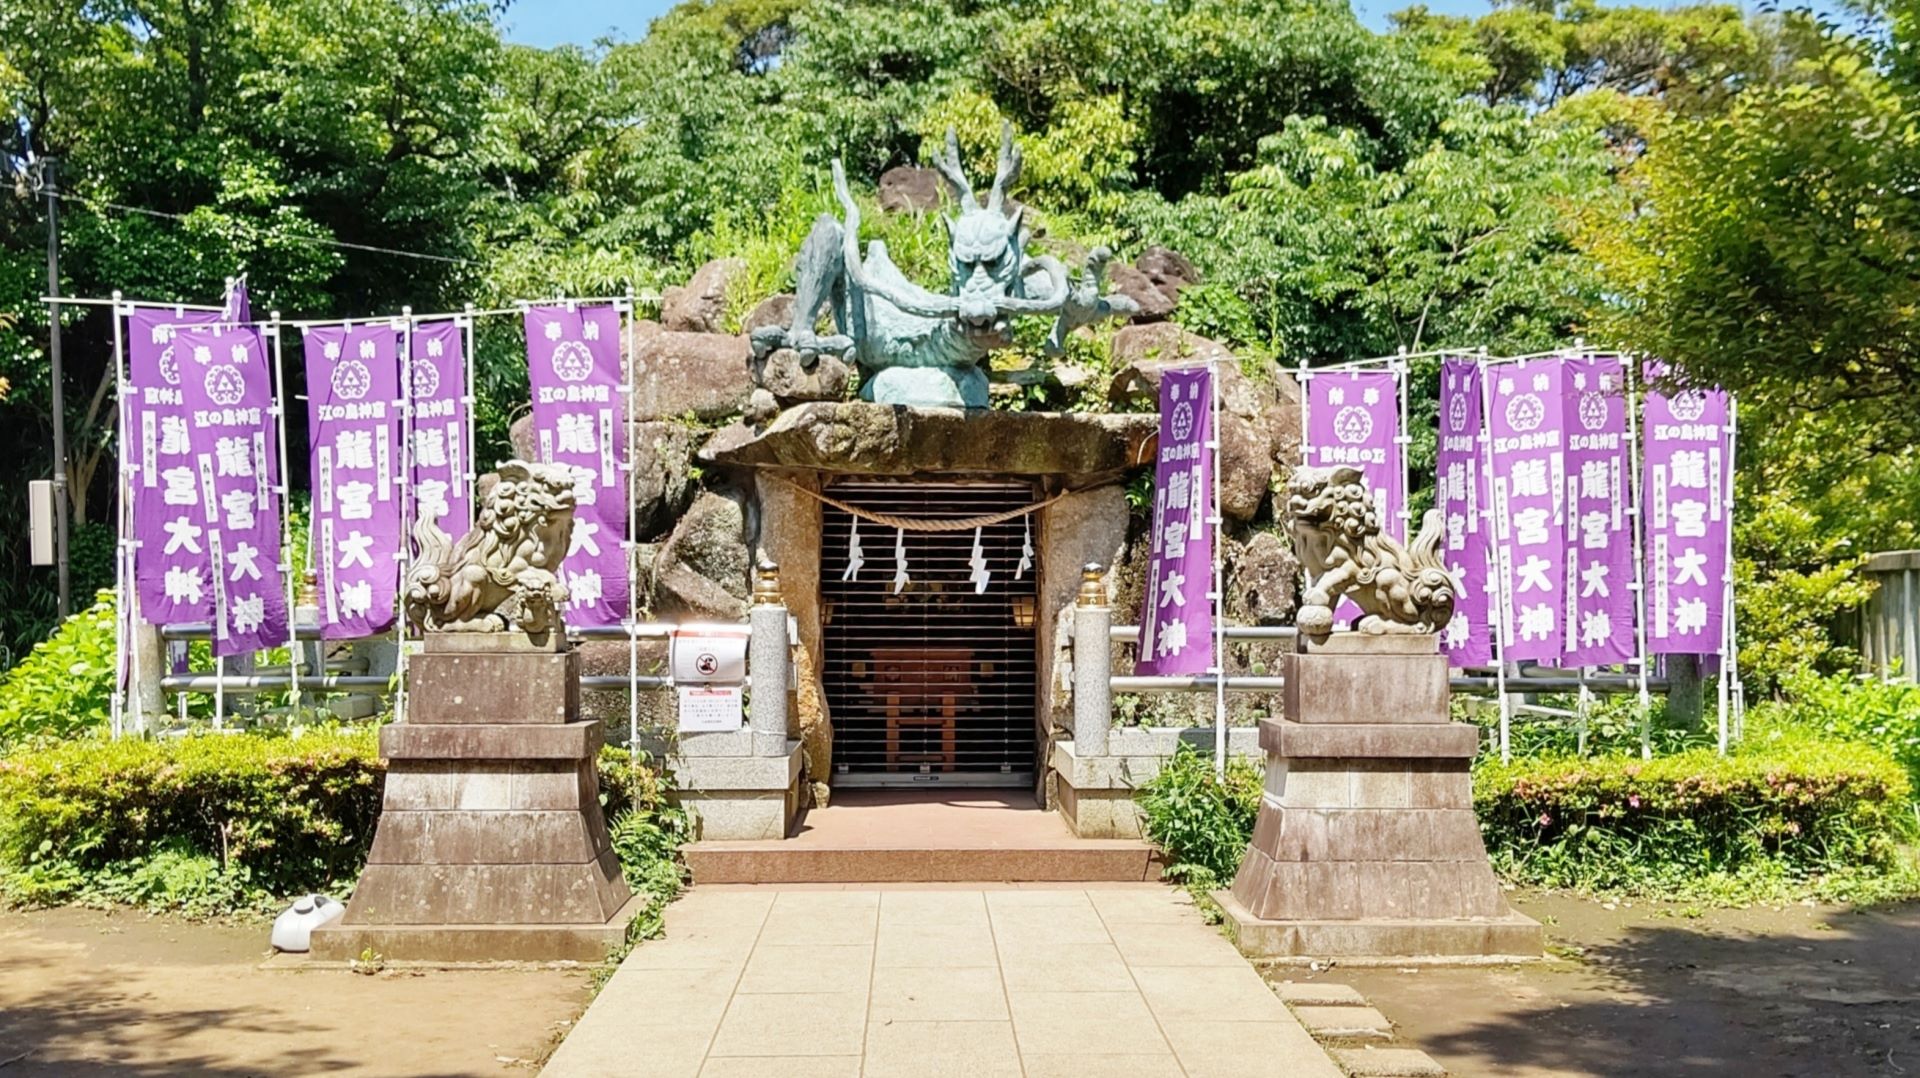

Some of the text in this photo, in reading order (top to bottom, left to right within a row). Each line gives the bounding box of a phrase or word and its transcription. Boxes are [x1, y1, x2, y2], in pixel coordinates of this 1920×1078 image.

[215, 436, 264, 635] 龍宮大神
[336, 429, 374, 619] 龍宮大神
[556, 413, 602, 610] 龍宮大神
[1157, 471, 1190, 657] 龍宮大神
[1445, 462, 1470, 650] 龍宮大神
[1511, 459, 1554, 641] 龍宮大神
[1580, 460, 1611, 648] 龍宮大神
[1670, 450, 1708, 636] 龍宮大神
